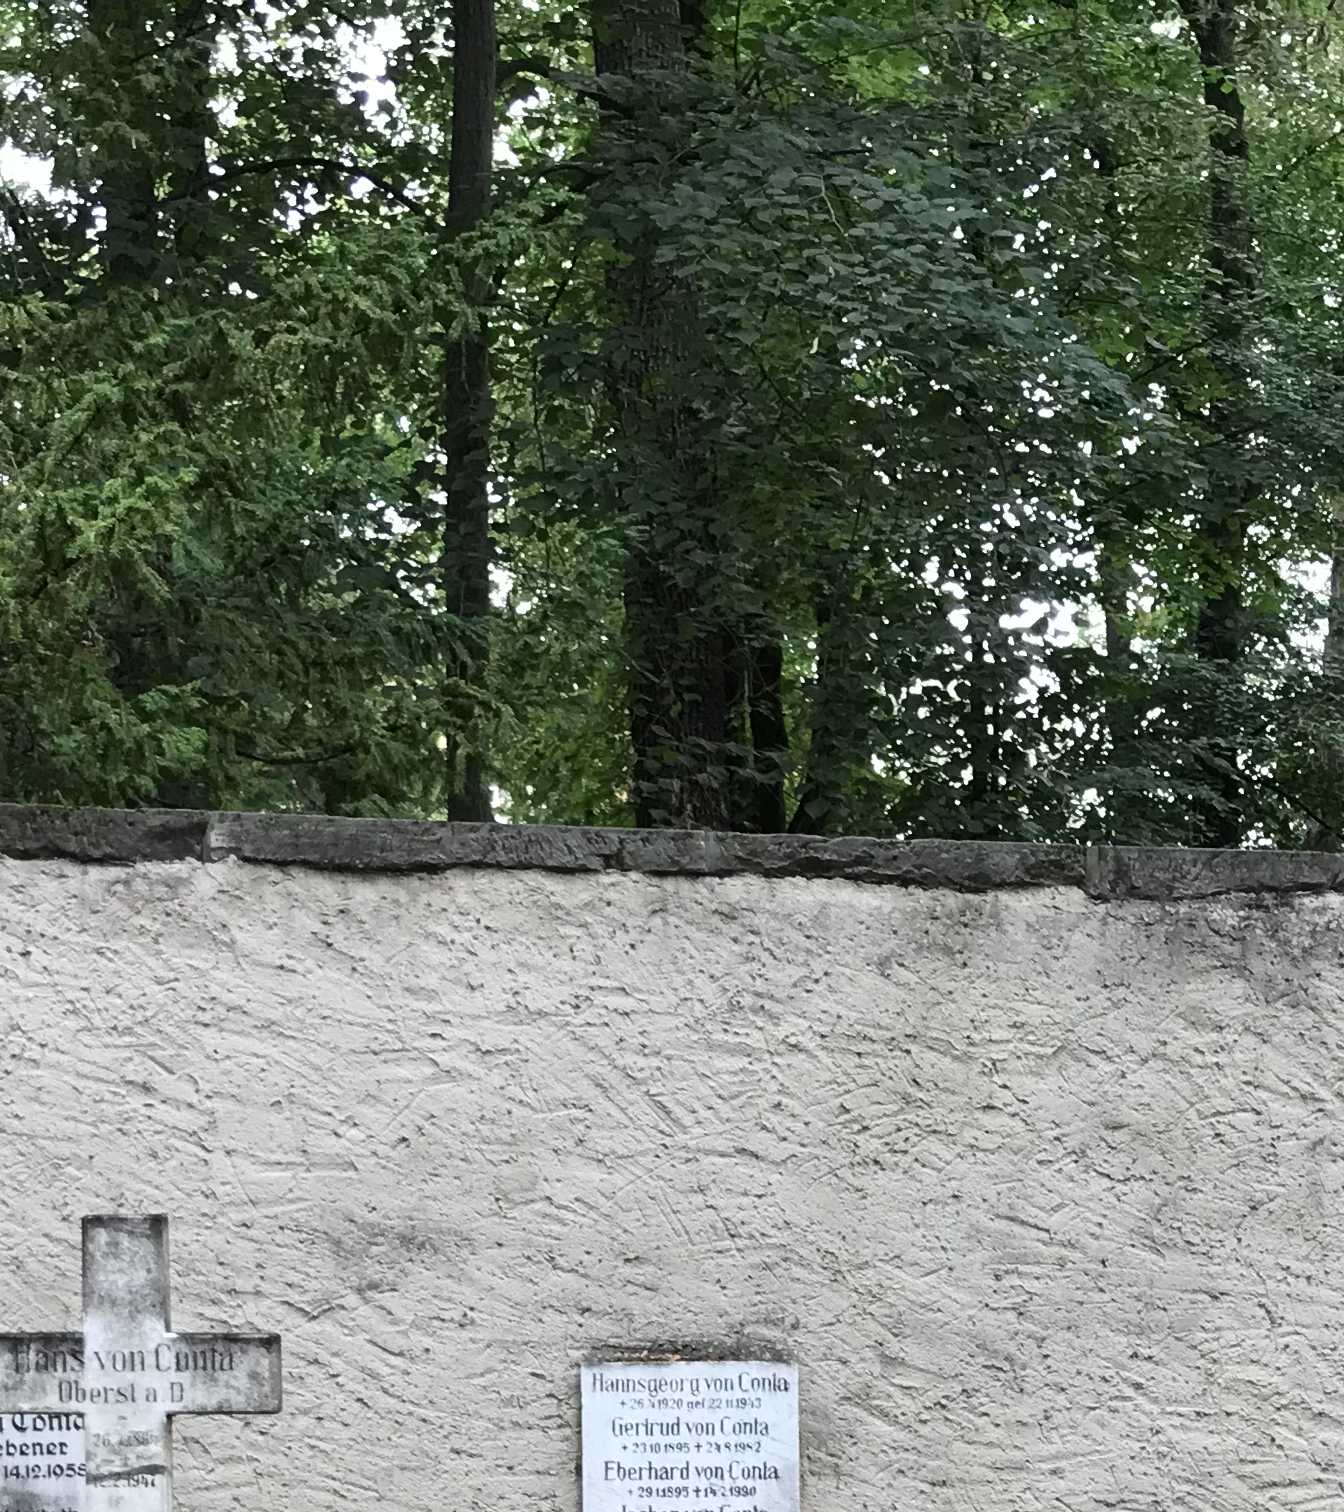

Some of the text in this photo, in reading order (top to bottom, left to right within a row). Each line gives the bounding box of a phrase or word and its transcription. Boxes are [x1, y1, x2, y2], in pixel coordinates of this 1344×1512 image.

[13, 1343, 235, 1374] Hans von Conta
[57, 1379, 138, 1405] Oberst
[591, 1371, 791, 1397] Hannsgeorg von Conta
[611, 1415, 770, 1438] Gertrud von Conta
[603, 1460, 781, 1482] Eberhard von Conta
